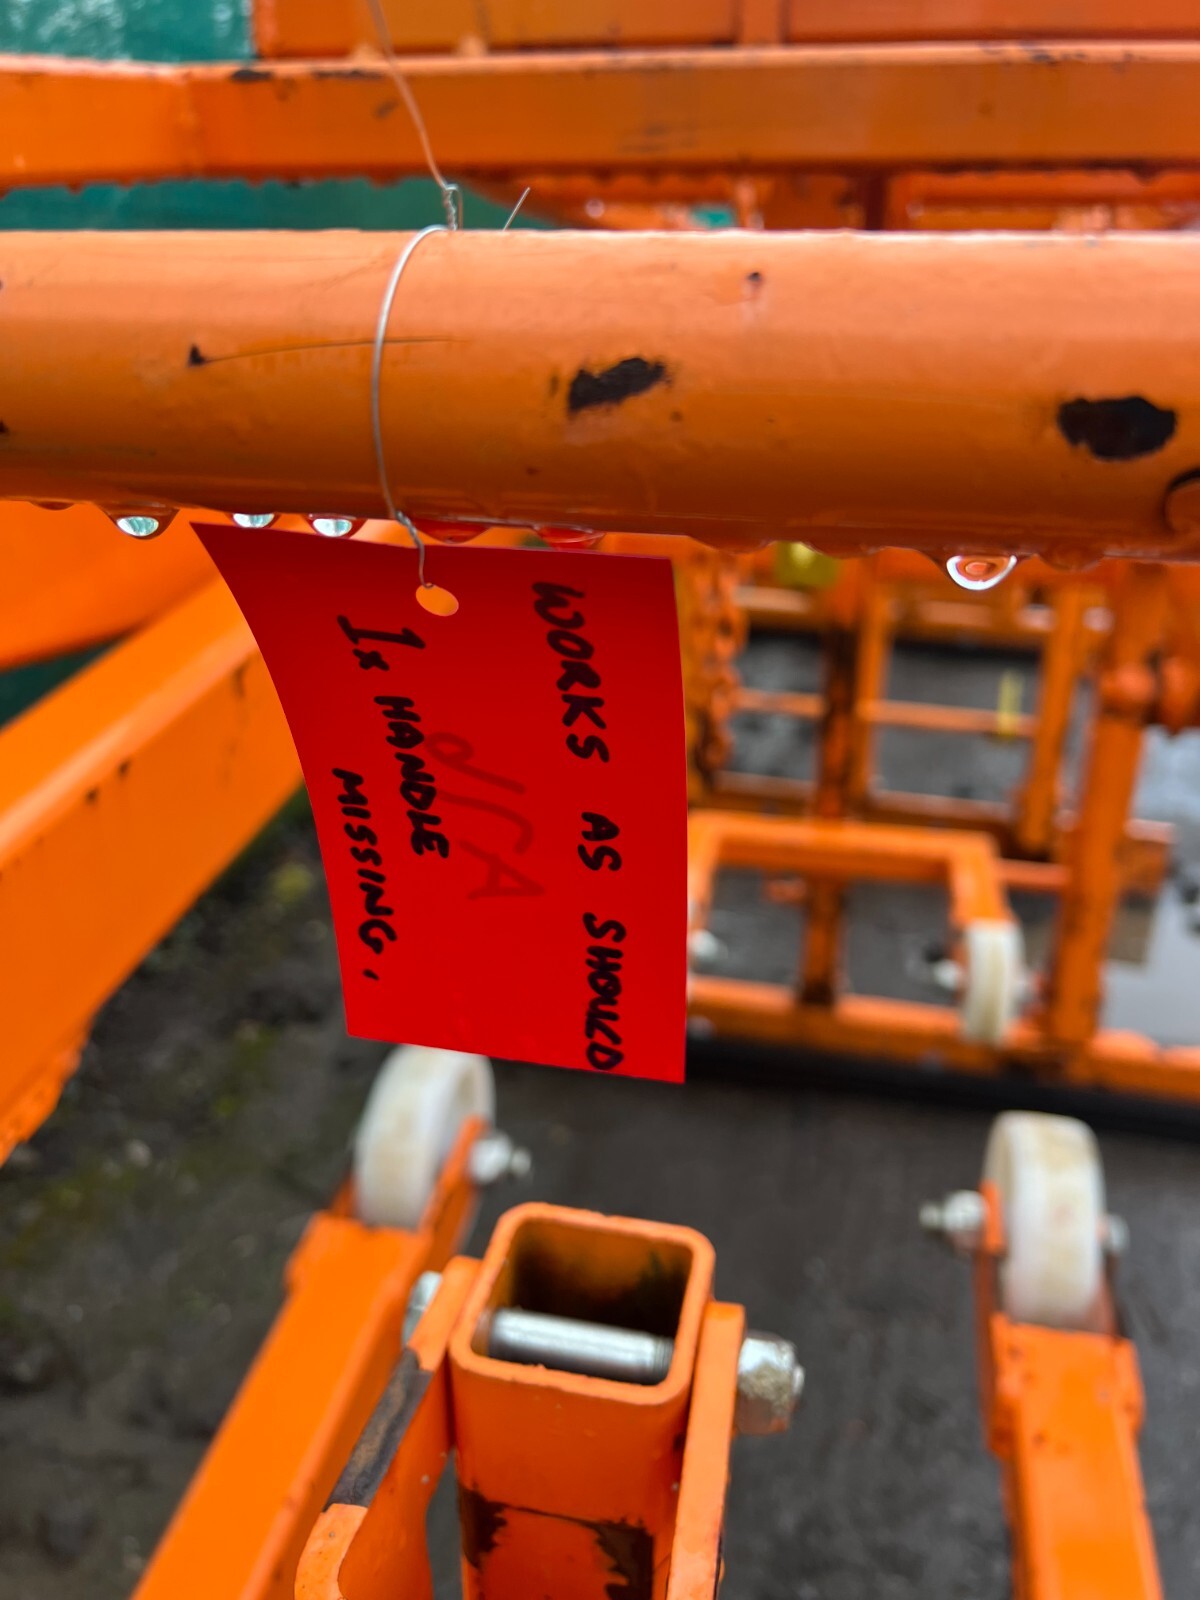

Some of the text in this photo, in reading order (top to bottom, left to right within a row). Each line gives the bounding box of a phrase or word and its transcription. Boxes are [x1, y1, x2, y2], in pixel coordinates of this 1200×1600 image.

[374, 695, 450, 859] HANDLE
[531, 580, 626, 1071] WORKS AS SHOULD
